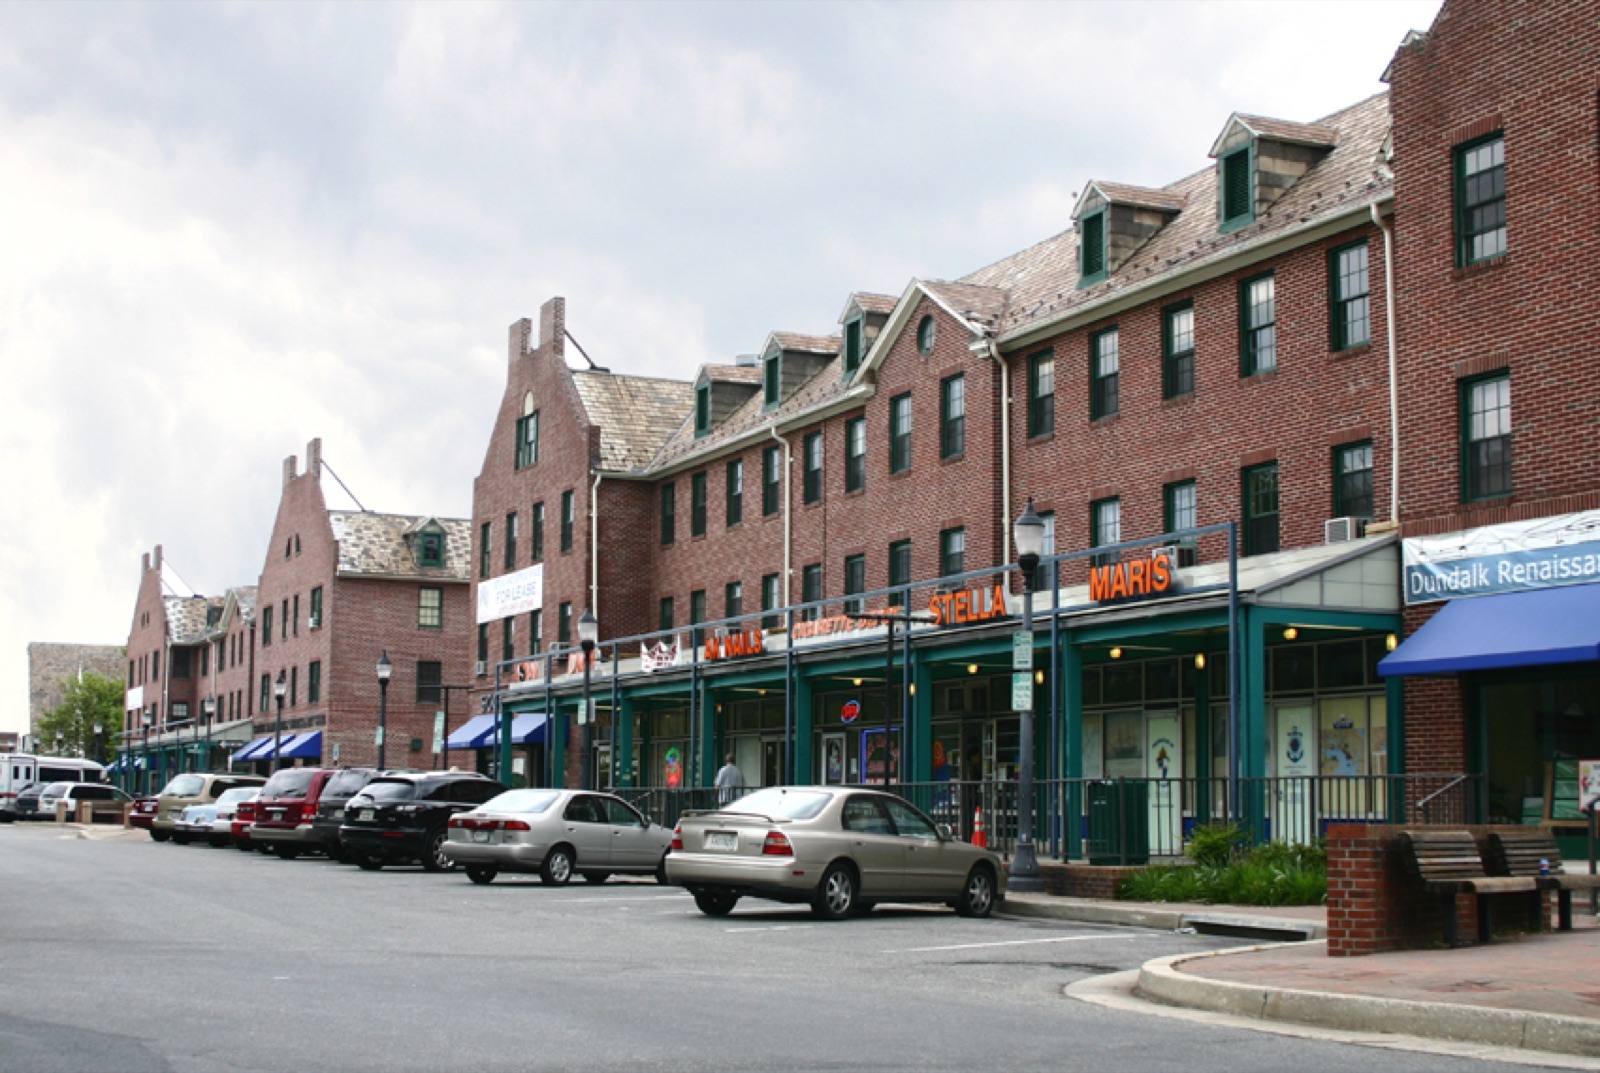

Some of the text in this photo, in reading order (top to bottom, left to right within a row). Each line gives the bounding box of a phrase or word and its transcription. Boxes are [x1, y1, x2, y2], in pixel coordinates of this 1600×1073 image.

[928, 554, 1172, 626] STELLA MARIS
[1411, 553, 1600, 595] Dundalk Renaissa
[723, 629, 763, 658] NAILS
